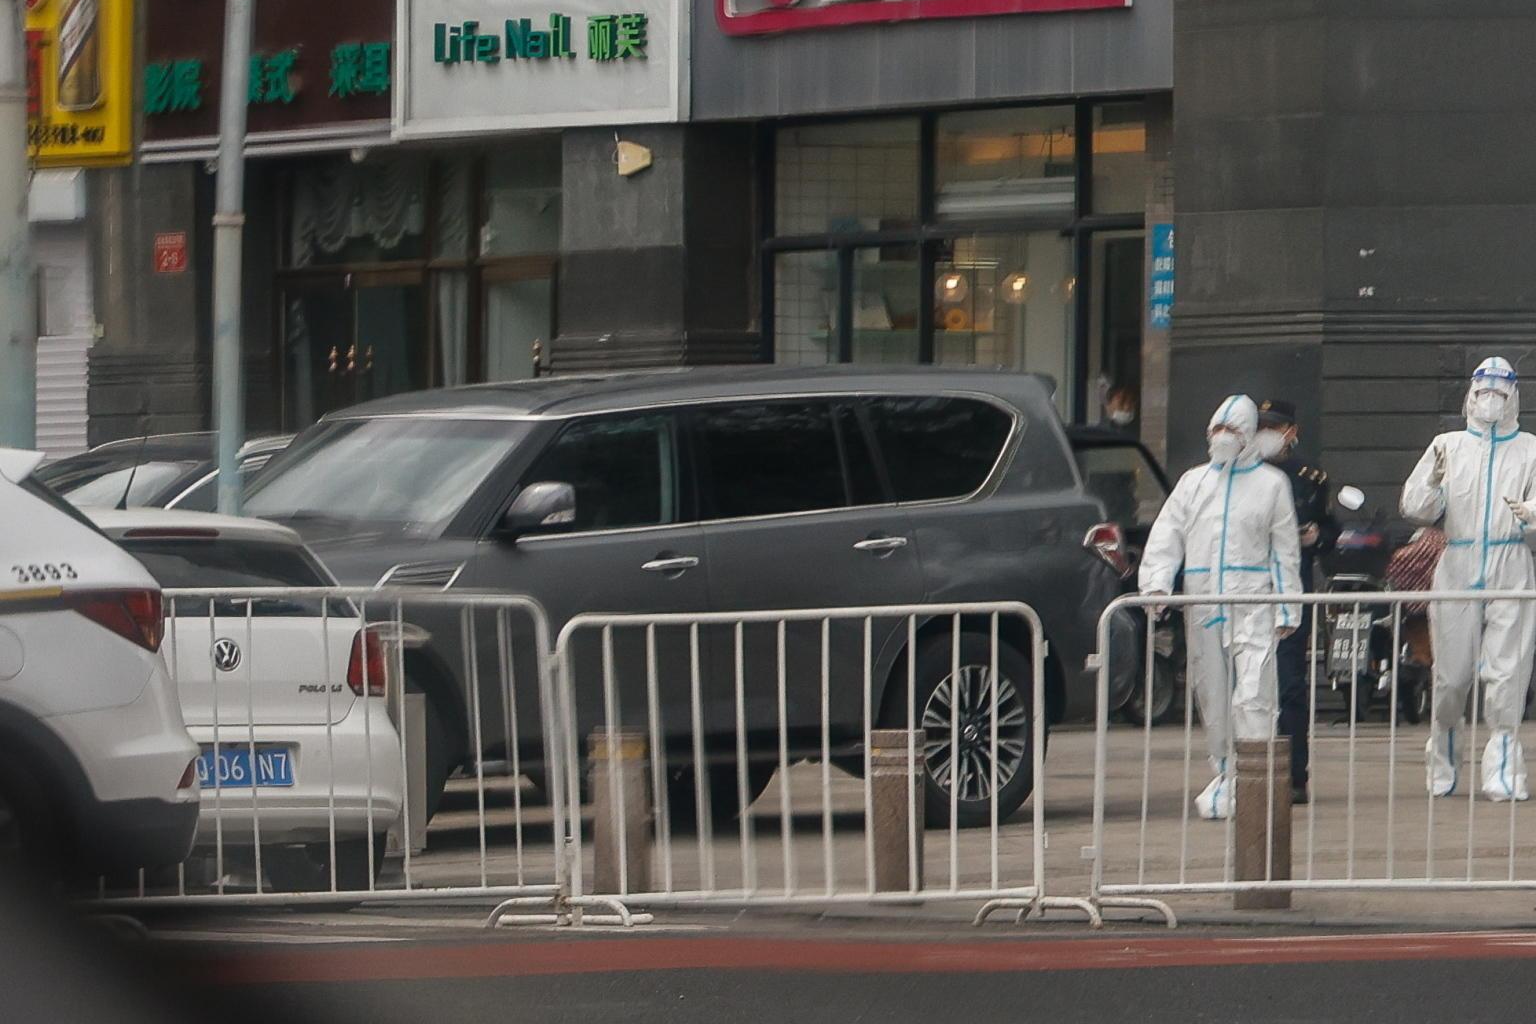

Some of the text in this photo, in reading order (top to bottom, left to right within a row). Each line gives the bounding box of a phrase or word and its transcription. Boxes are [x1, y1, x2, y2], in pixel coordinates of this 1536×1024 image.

[434, 12, 649, 64] Life Nail 丽芙
